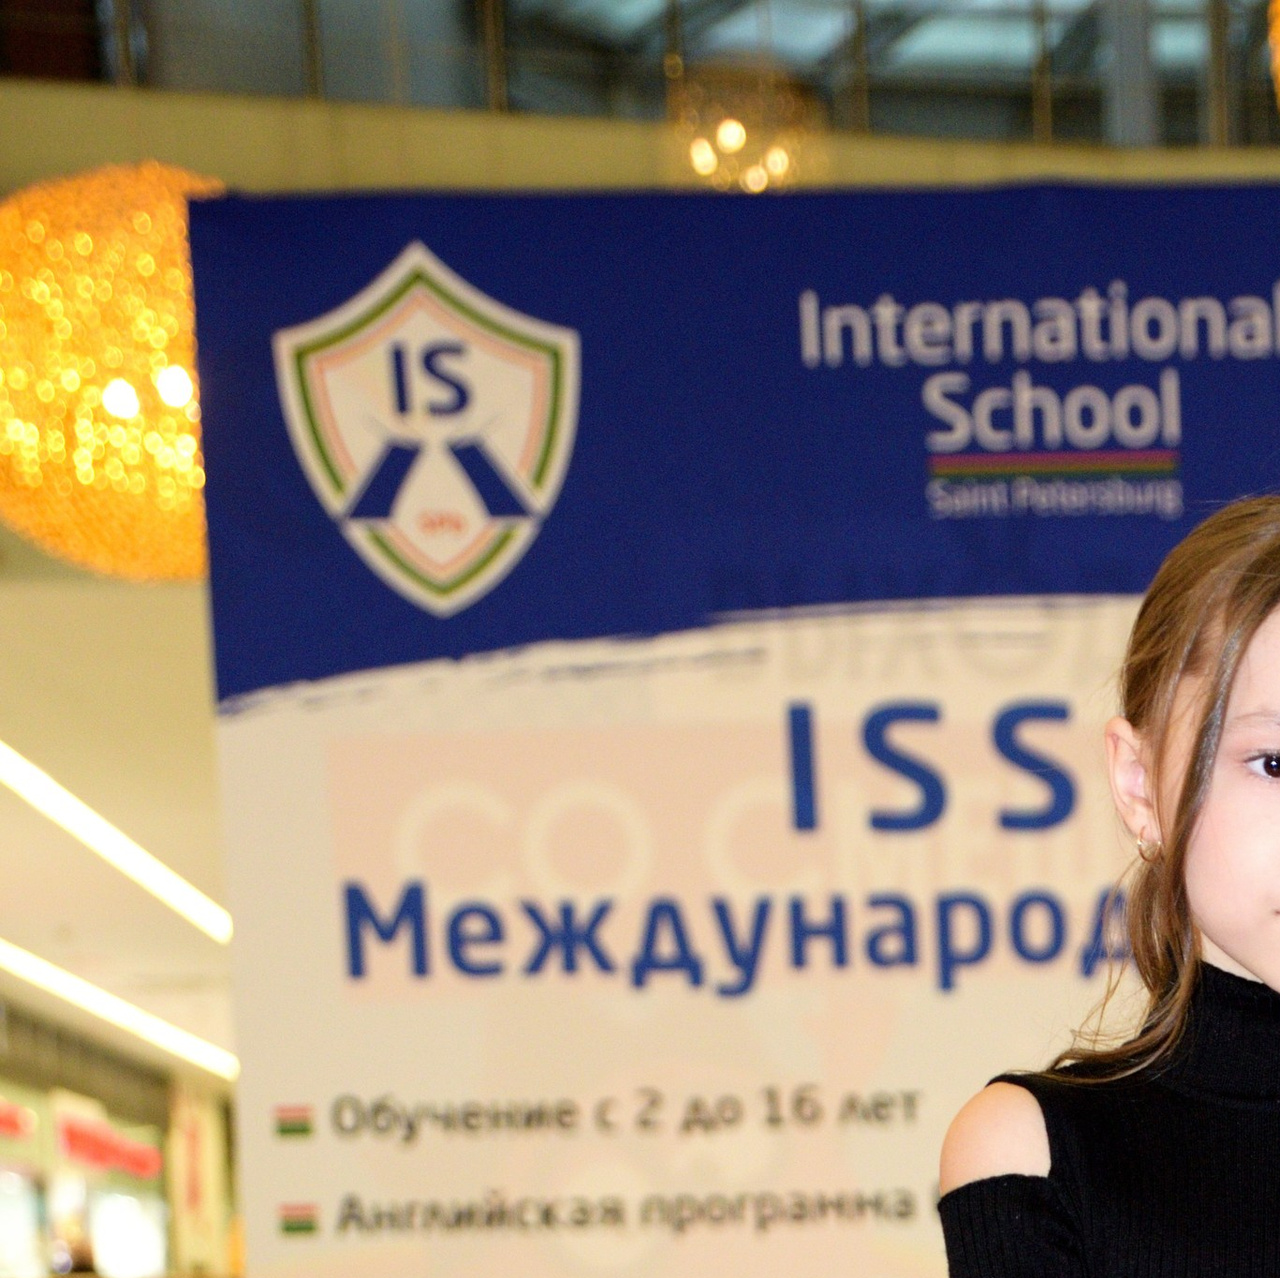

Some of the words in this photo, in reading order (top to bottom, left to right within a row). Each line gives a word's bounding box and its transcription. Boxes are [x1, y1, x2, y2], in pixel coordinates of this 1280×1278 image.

[388, 340, 474, 416] IS
[921, 366, 1182, 452] School
[926, 477, 1008, 519] Saint
[340, 878, 1135, 998] Международ
[331, 1095, 580, 1142] Обучение
[594, 1099, 618, 1134] с
[634, 1090, 668, 1130] 2
[680, 1097, 744, 1134] до
[763, 1086, 821, 1124] 16
[838, 1090, 922, 1126] лет
[336, 1188, 625, 1234] Английская
[640, 1185, 918, 1233] программа
